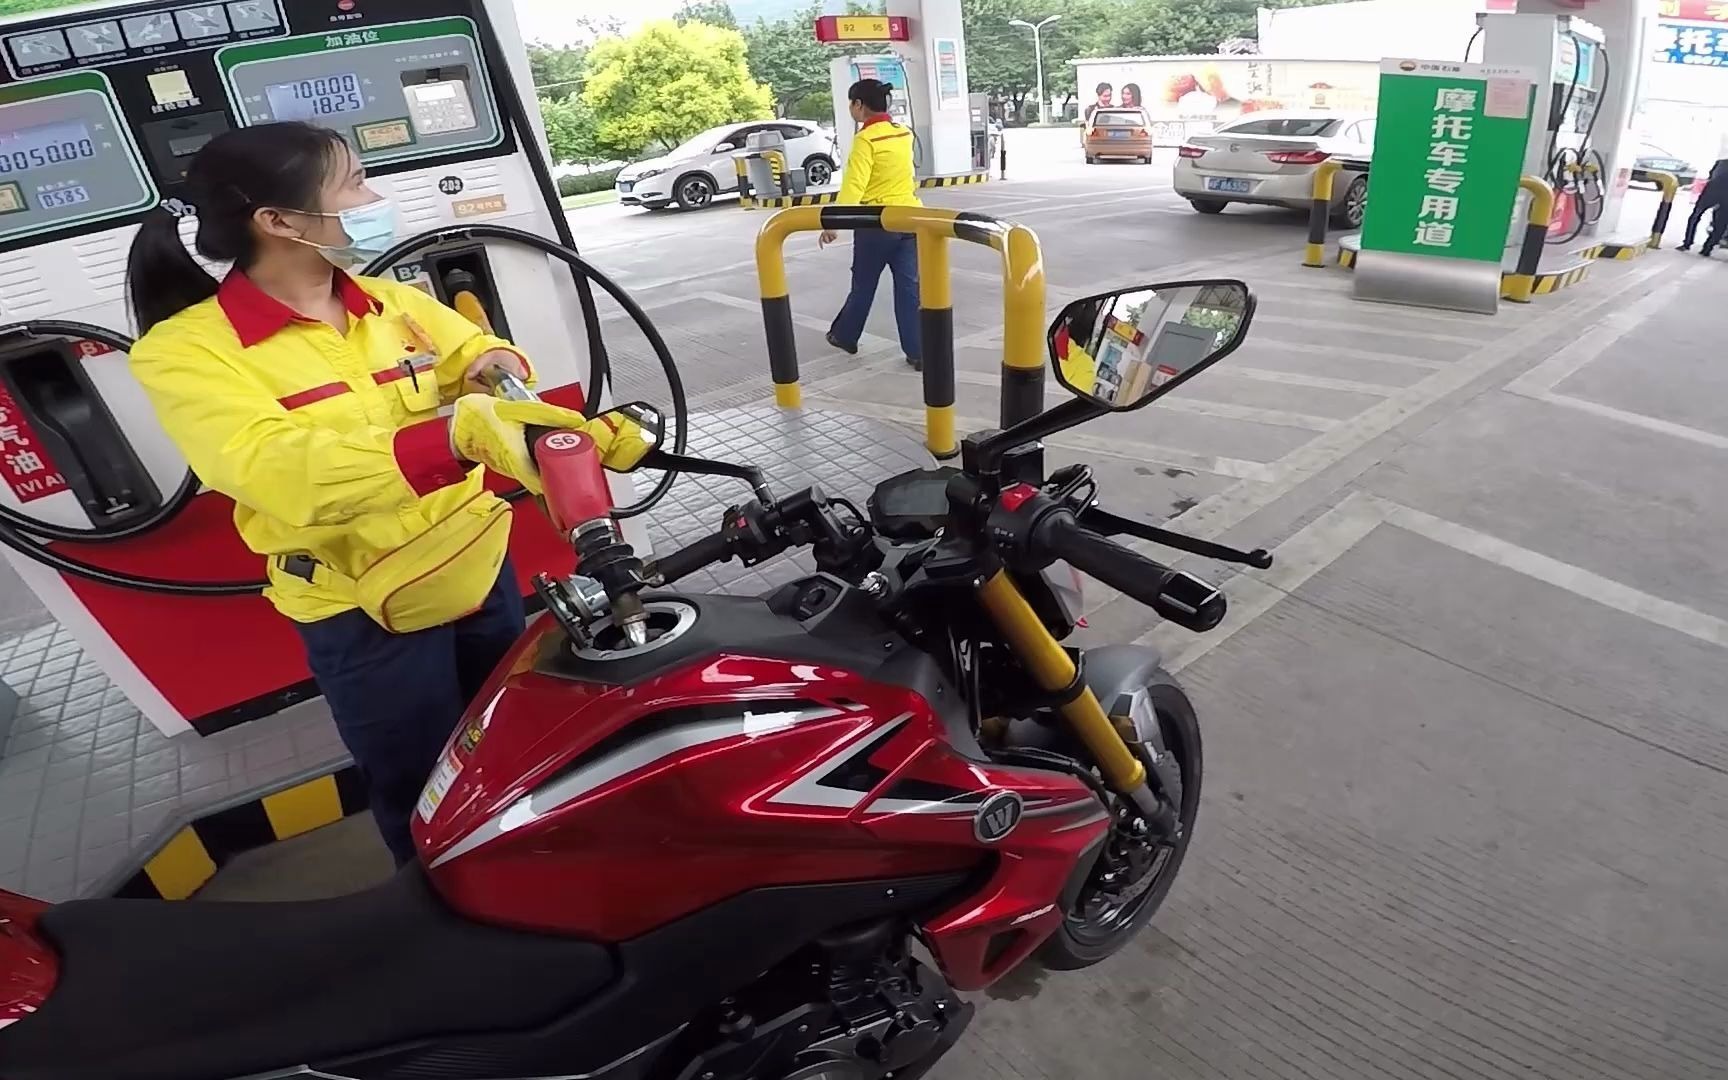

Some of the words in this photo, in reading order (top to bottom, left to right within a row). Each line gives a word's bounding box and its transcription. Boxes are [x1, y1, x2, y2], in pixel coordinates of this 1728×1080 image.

[843, 23, 855, 32] 92
[872, 23, 884, 32] 95
[891, 22, 899, 32] 3
[293, 75, 355, 99] 100.00
[312, 93, 360, 115] 18.25
[1412, 88, 1479, 248] 摩托车专用道
[397, 264, 422, 279] B2
[550, 435, 576, 448] 95
